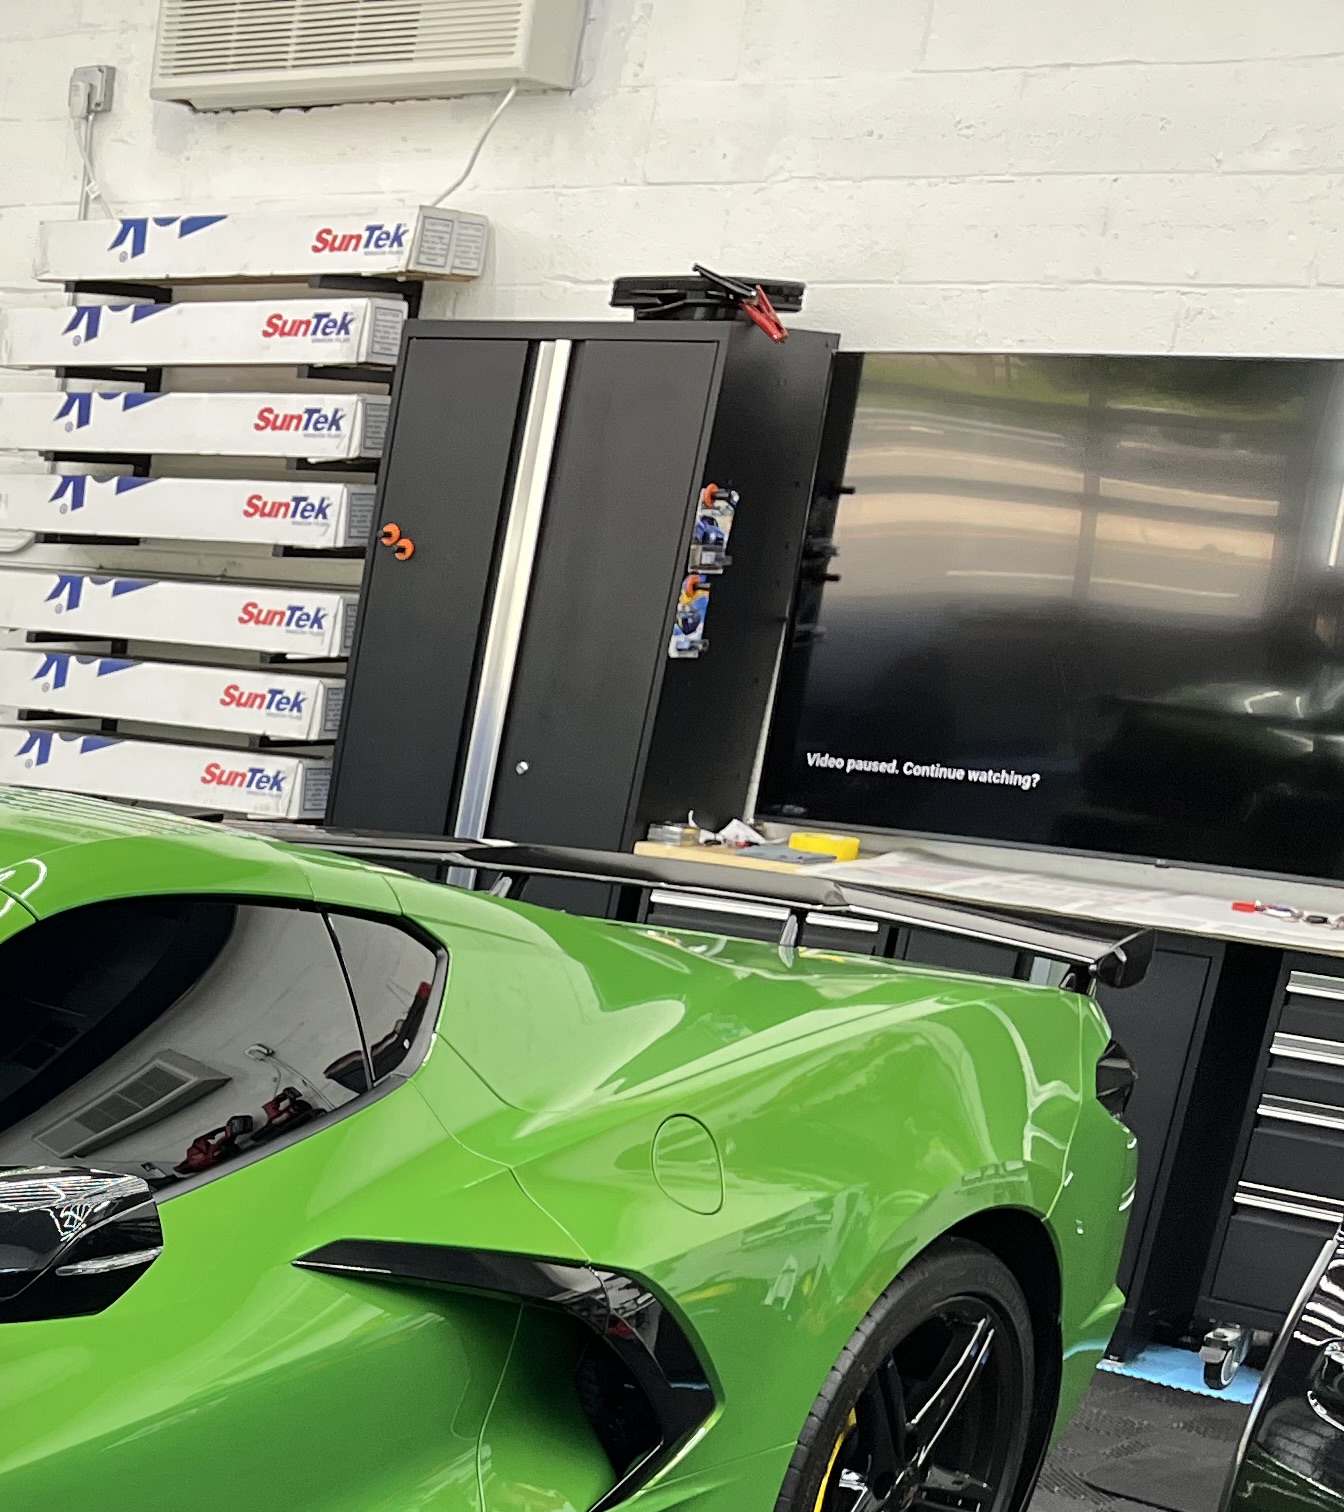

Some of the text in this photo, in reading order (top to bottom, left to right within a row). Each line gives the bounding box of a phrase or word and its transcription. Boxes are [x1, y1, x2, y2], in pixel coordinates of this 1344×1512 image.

[312, 223, 409, 253] SunTek
[262, 312, 355, 338] SunTek
[254, 407, 346, 431] SunTek
[243, 494, 333, 519] SunTek
[238, 601, 328, 630] SunTek
[219, 684, 307, 713] SunTek
[200, 763, 287, 792] SunTek
[806, 752, 1042, 791] Video paused. Continue watching?
